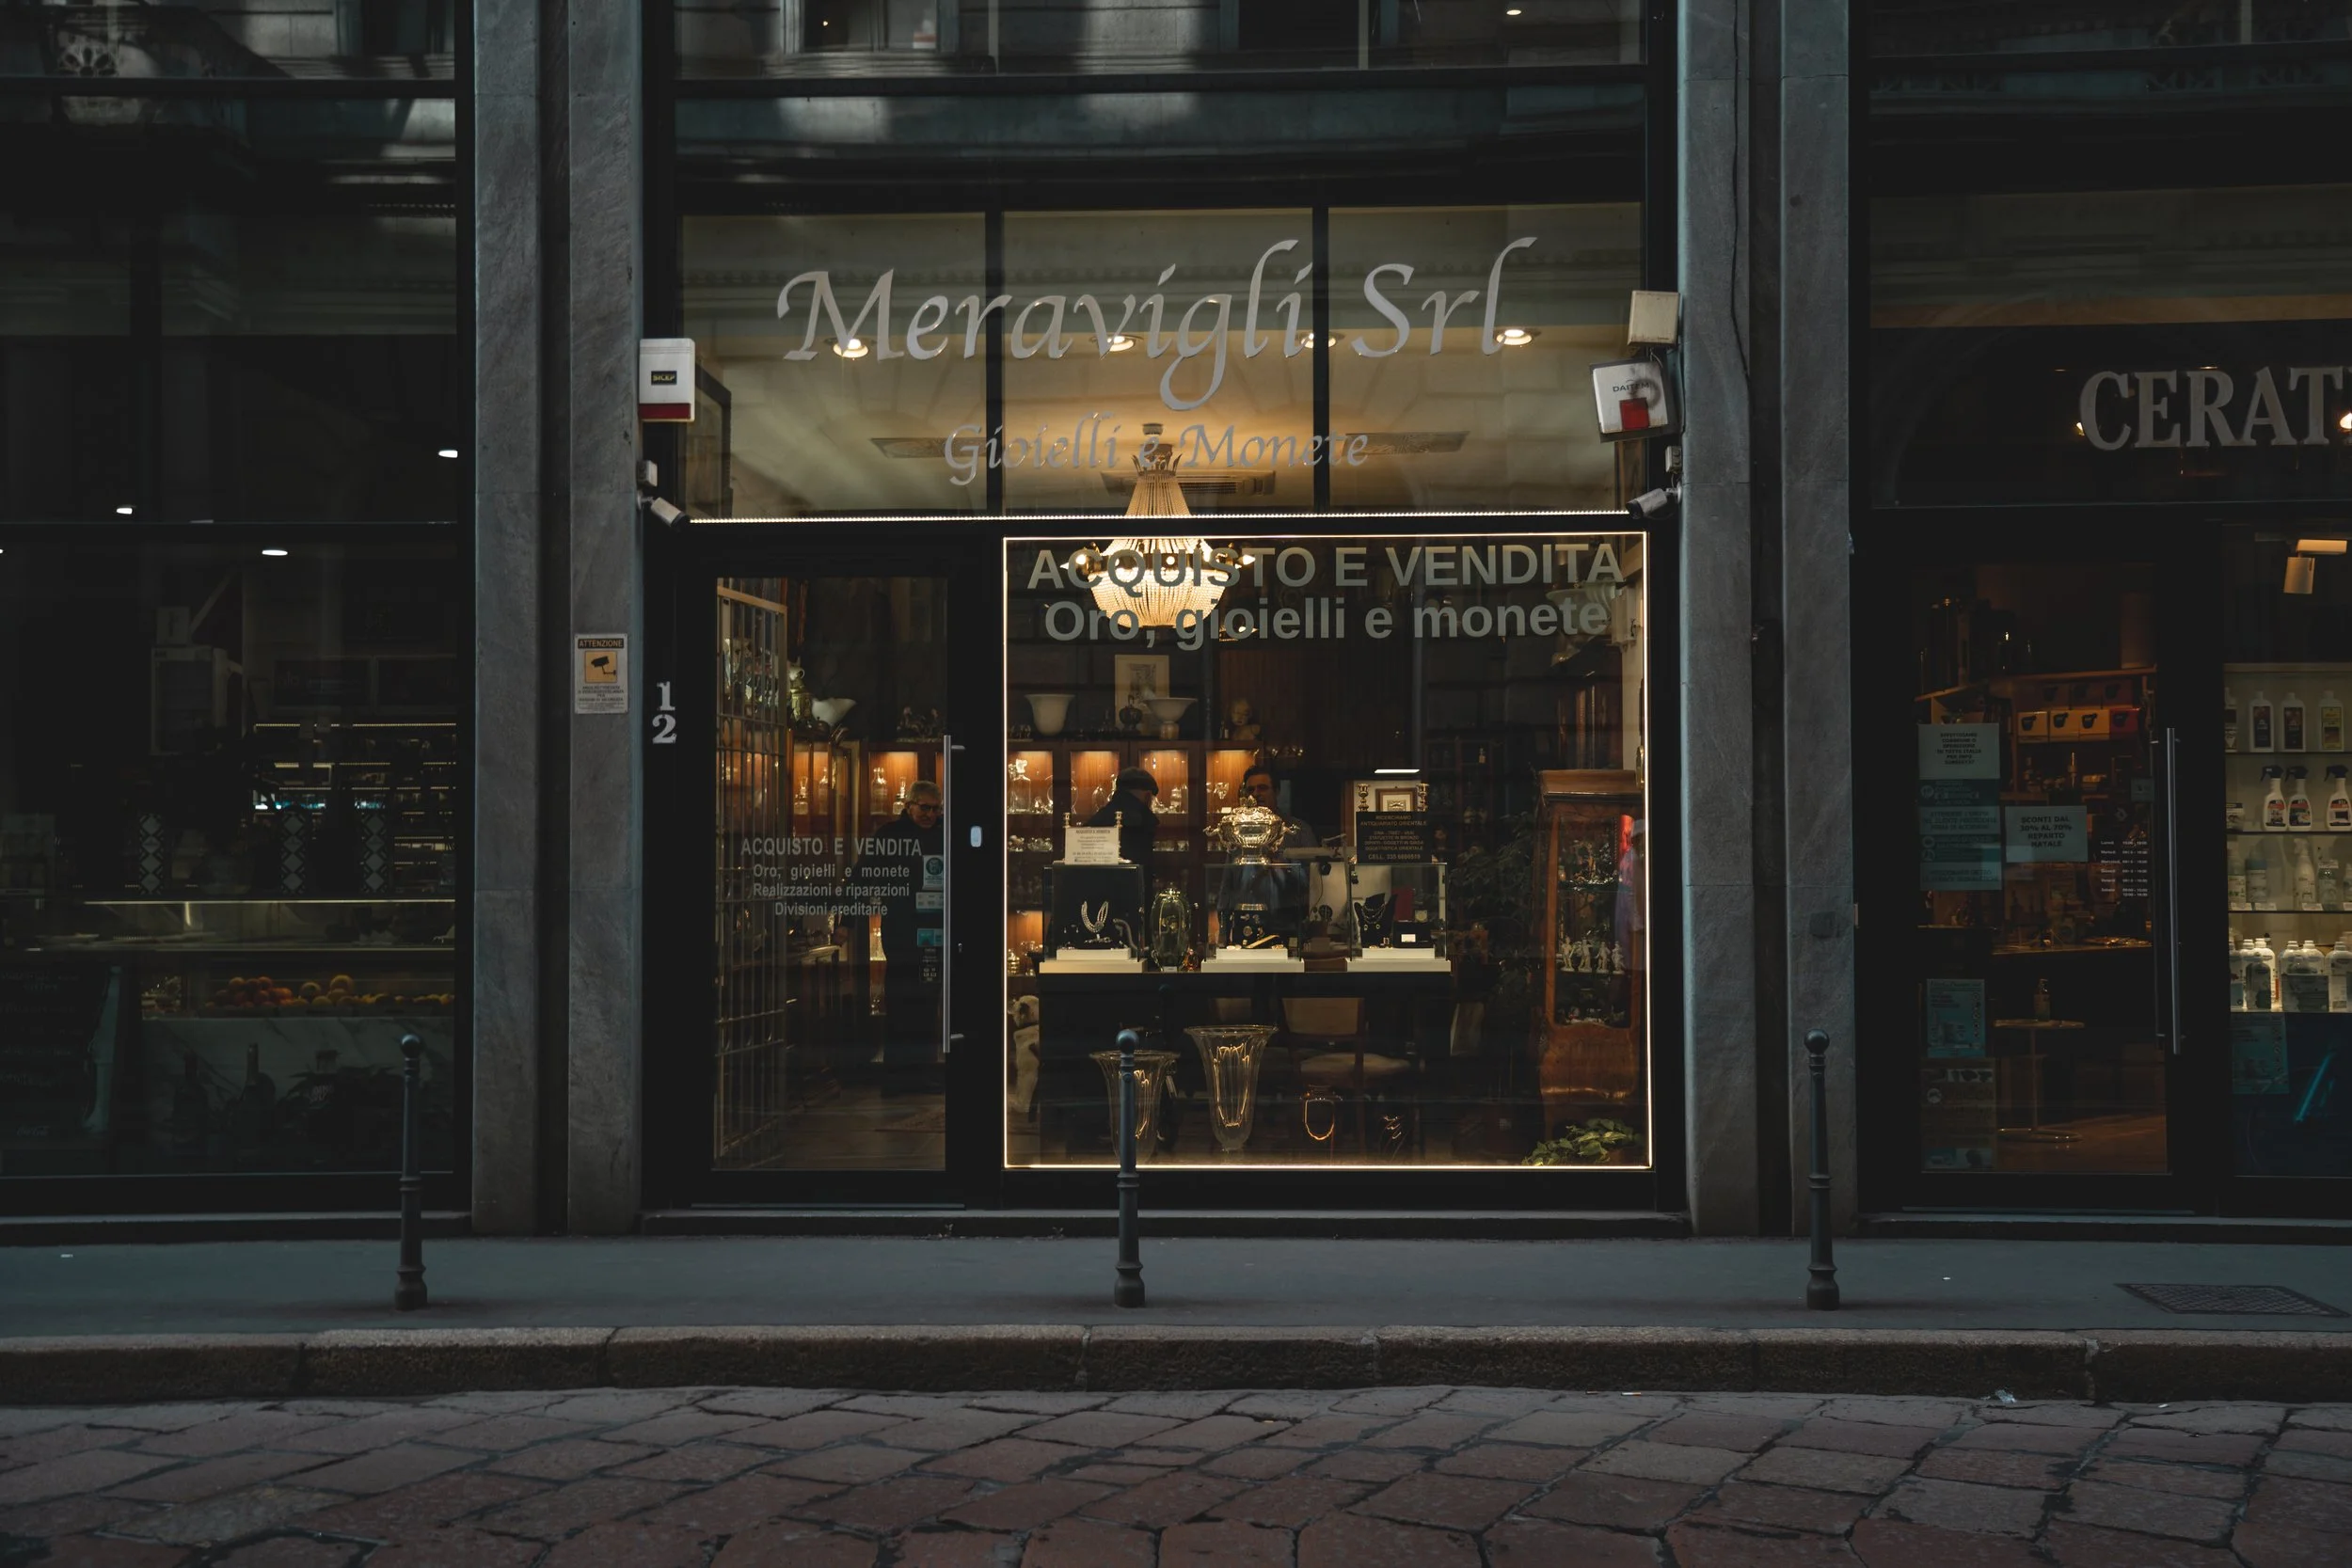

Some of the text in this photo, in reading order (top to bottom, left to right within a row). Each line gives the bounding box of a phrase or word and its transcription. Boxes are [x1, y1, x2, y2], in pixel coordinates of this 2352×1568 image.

[777, 237, 1537, 411] Meravigli Srl
[2079, 366, 2352, 451] CERAT
[945, 412, 1368, 485] Gioielli e Monete
[1026, 544, 1626, 597] ACQUISTO E VENDITA
[1045, 596, 1607, 651] Oro, gioielli e monete
[579, 640, 624, 648] ATTENZIONE
[740, 837, 922, 856] ACQUISTO E VENDITA
[753, 863, 910, 880] Oro, gioielli e monete
[754, 882, 910, 899] Realizzazioni e riparazioni
[774, 902, 888, 915] Divisioni ereditarie
